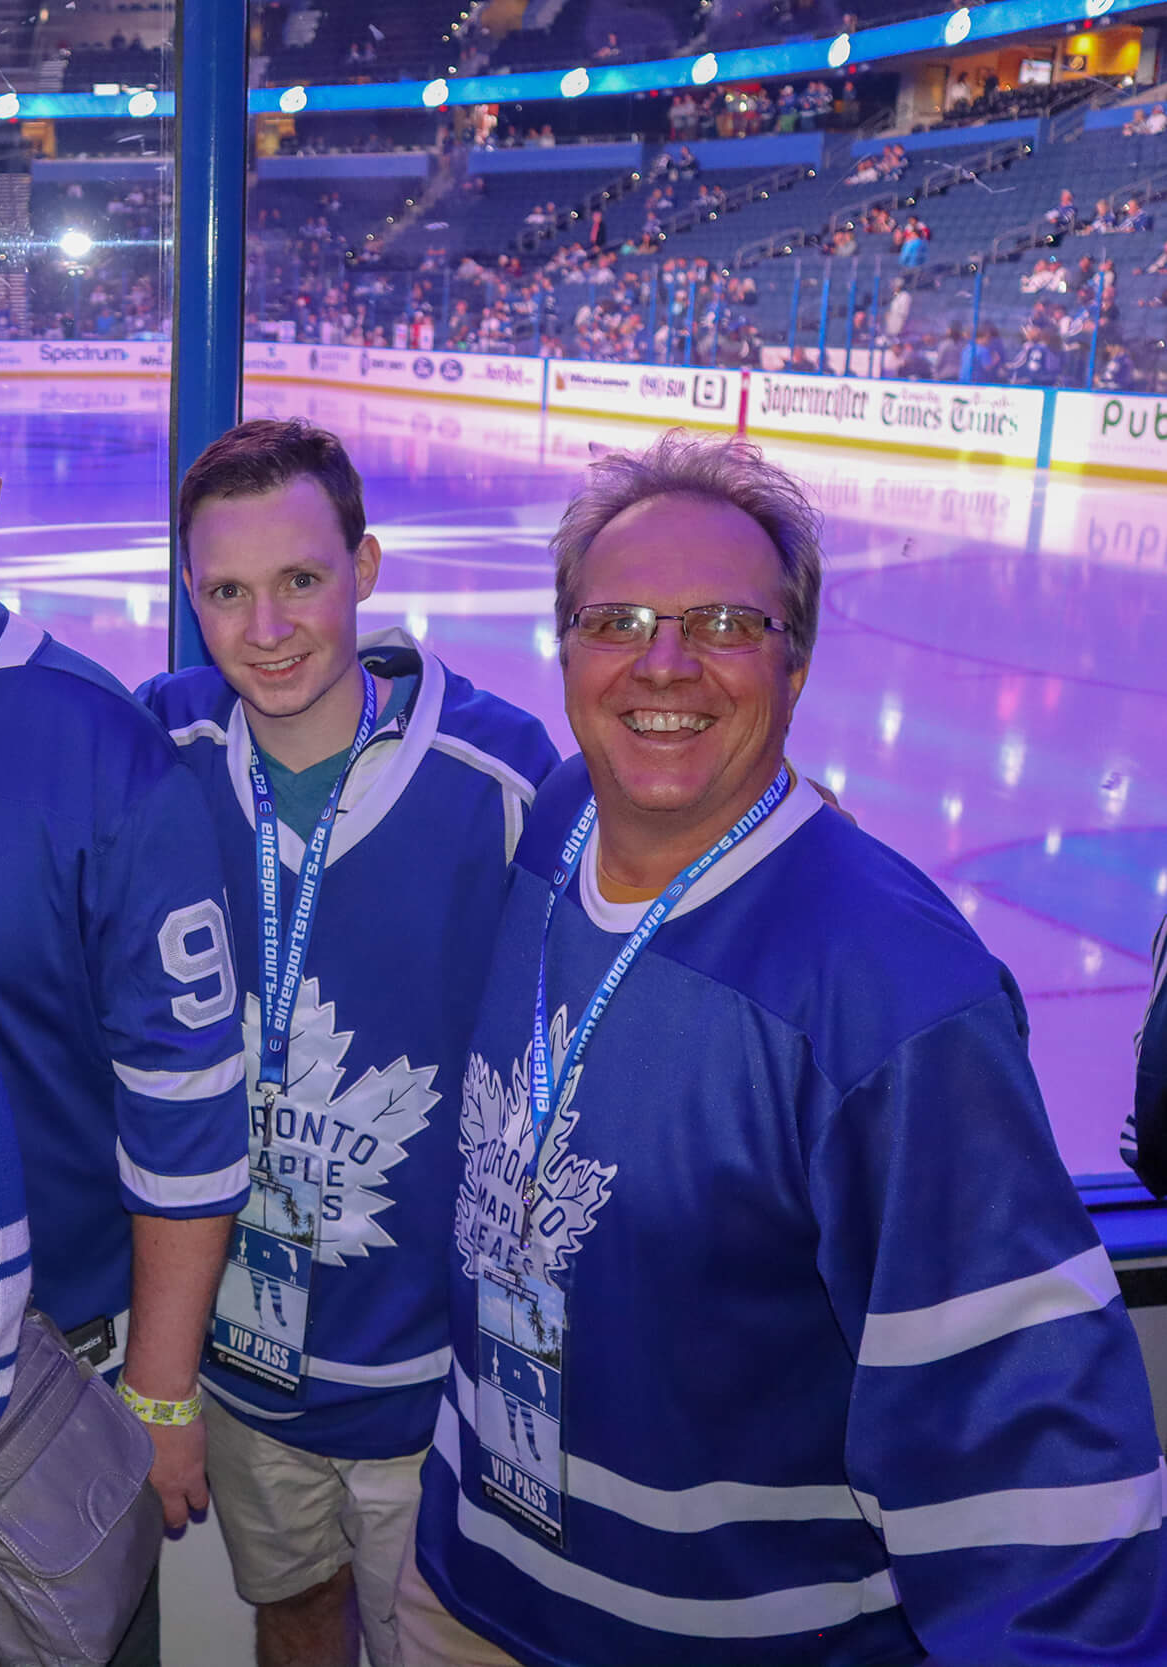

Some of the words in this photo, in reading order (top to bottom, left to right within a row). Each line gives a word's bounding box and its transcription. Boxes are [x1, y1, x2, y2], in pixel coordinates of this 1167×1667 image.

[39, 344, 124, 364] Spectrum
[881, 391, 943, 431] Times
[951, 397, 1019, 437] Times
[157, 898, 238, 1030] 9
[250, 1105, 379, 1166] RONTO
[258, 1150, 345, 1189] APLE
[477, 1183, 534, 1239] MAPL
[229, 1325, 253, 1353] VIP
[254, 1336, 290, 1371] PASS
[491, 1455, 513, 1489] VIP
[515, 1470, 548, 1512] PASS
